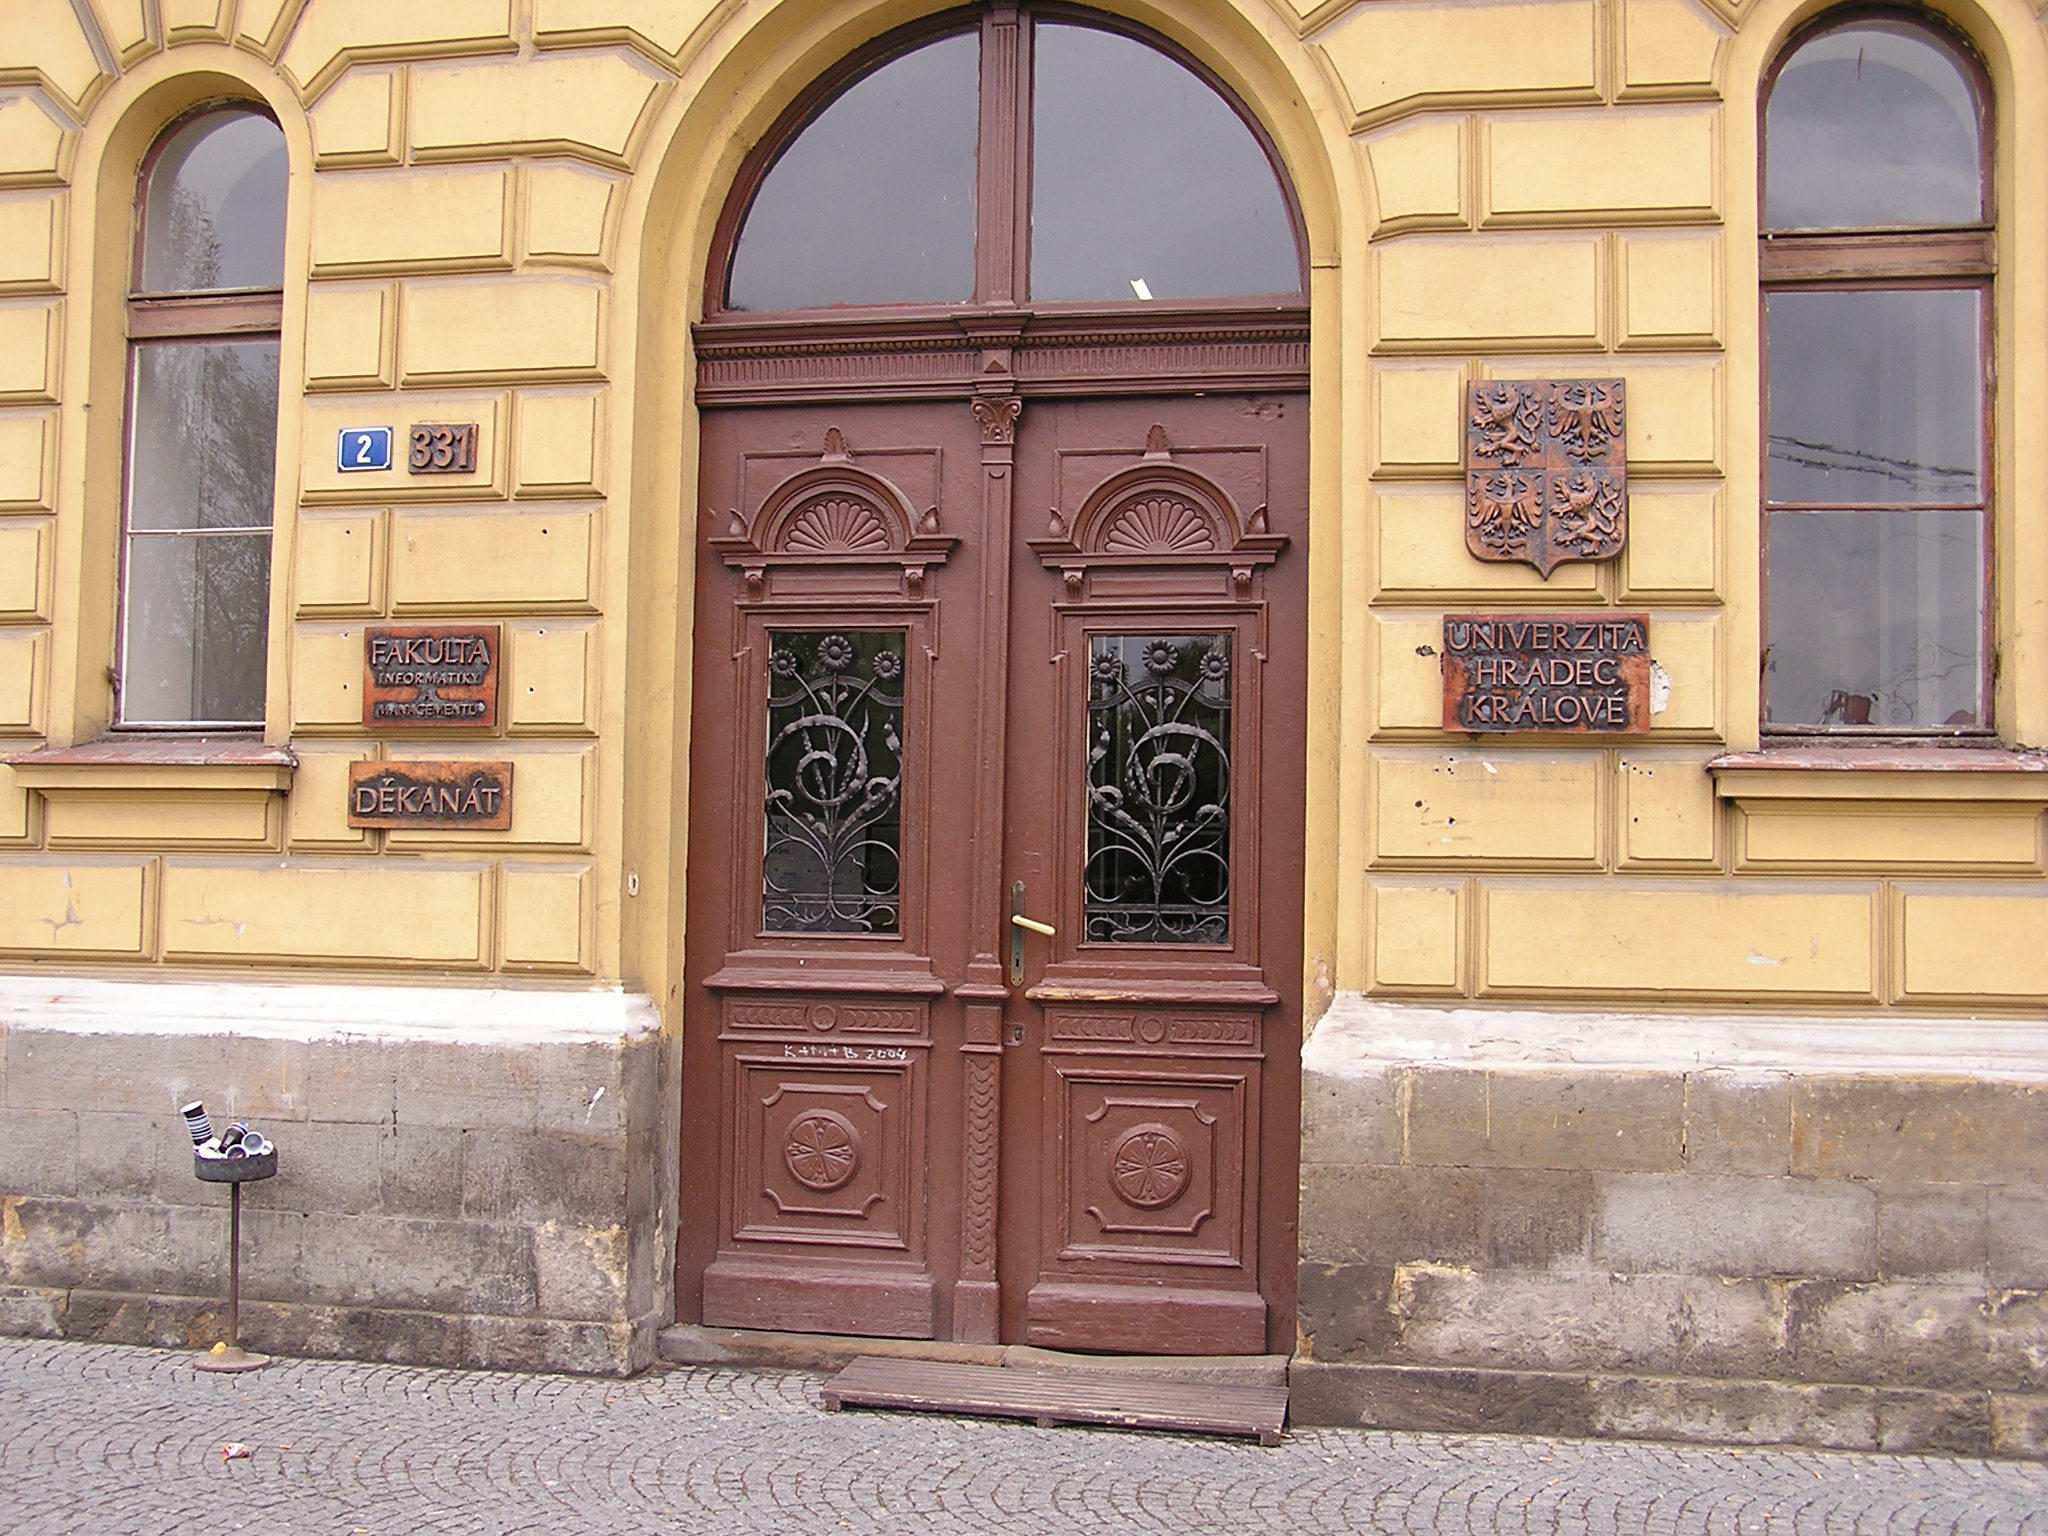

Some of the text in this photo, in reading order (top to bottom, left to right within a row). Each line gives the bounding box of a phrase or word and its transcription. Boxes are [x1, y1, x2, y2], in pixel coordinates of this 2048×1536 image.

[357, 435, 372, 463] 2
[412, 429, 469, 467] 331
[1448, 623, 1645, 650] UNIVERZITA
[371, 639, 491, 665] FAKULTA
[378, 671, 480, 686] INFORMATIKY
[1476, 658, 1617, 686] HRADEC
[1466, 687, 1625, 724] KRÁLOVÉ
[355, 777, 500, 815] DĚKANÁT
